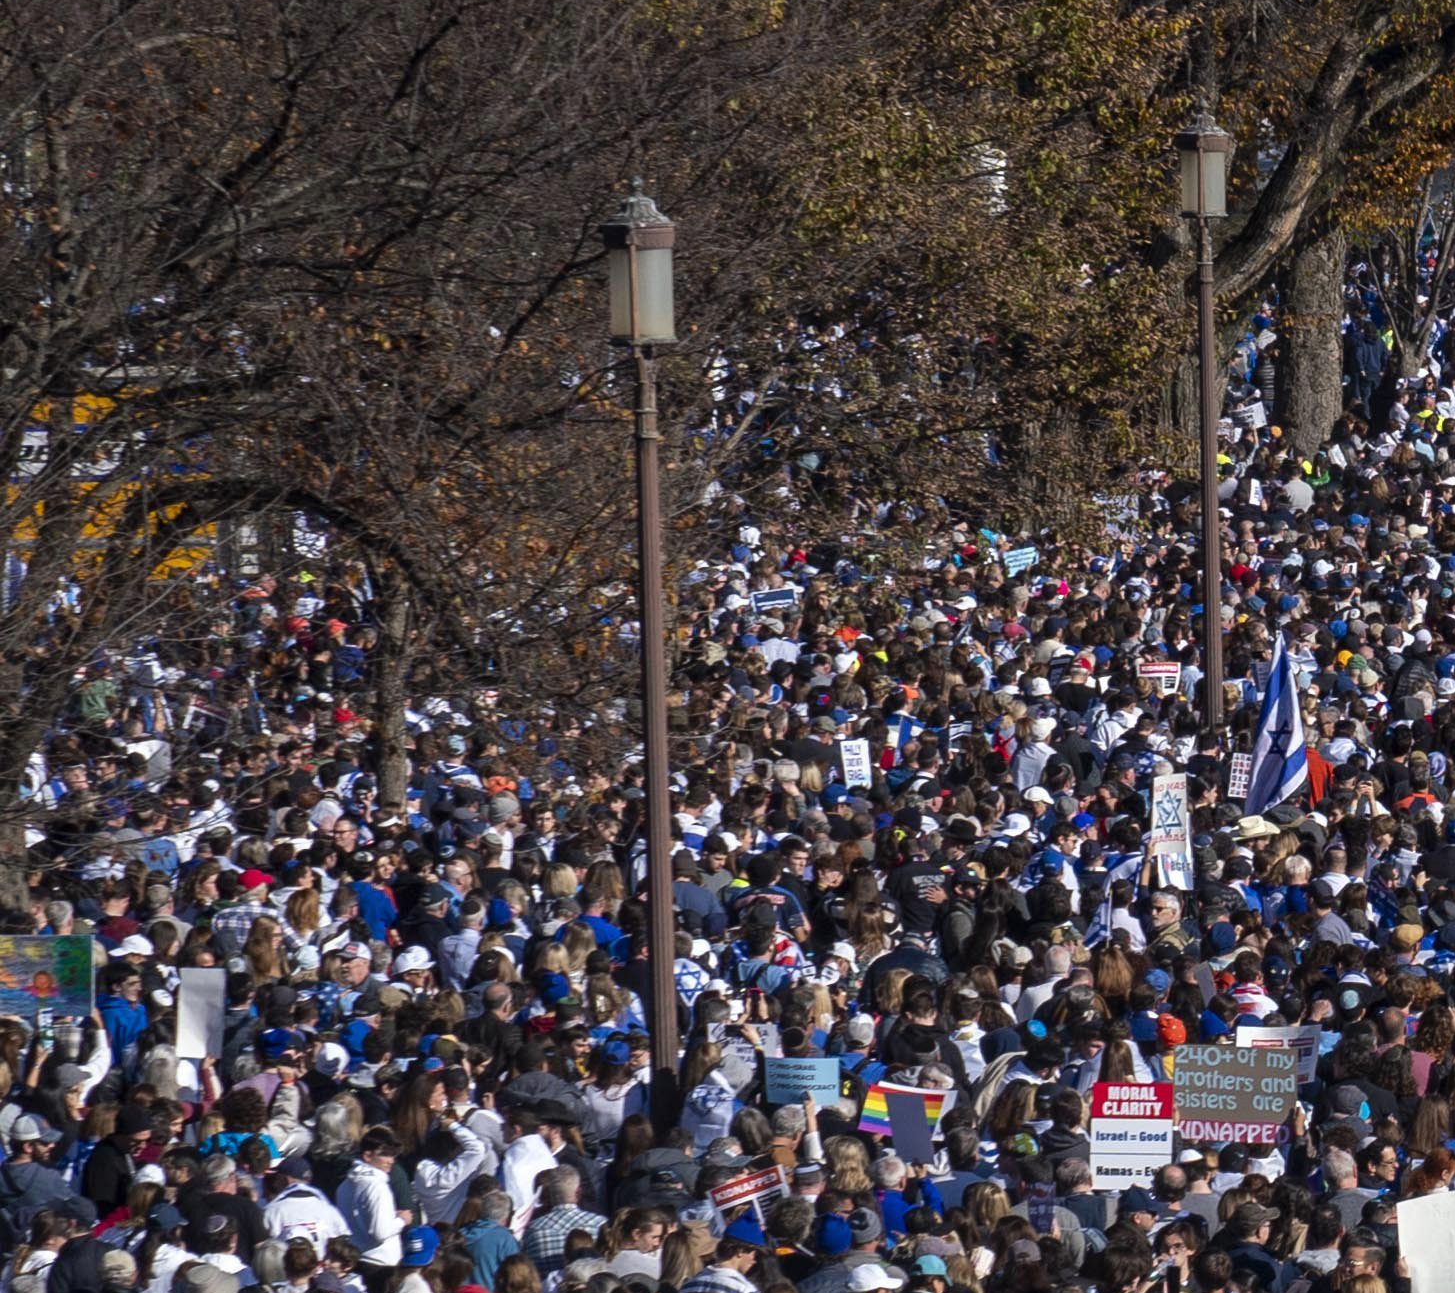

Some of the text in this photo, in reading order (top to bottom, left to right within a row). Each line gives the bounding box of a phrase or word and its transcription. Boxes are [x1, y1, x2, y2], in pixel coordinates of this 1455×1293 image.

[1174, 1046, 1295, 1070] 240+ of my
[1174, 1067, 1295, 1093] brothers and
[1107, 1086, 1157, 1101] MORAL
[1174, 1091, 1284, 1111] sisters are
[1102, 1101, 1162, 1116] CLARITY
[1095, 1131, 1128, 1142] Israel
[1139, 1131, 1168, 1143] Good
[1177, 1122, 1290, 1144] KIDNAPPED
[1095, 1166, 1134, 1177] Hamas
[715, 1173, 778, 1200] KIDNAPPED
